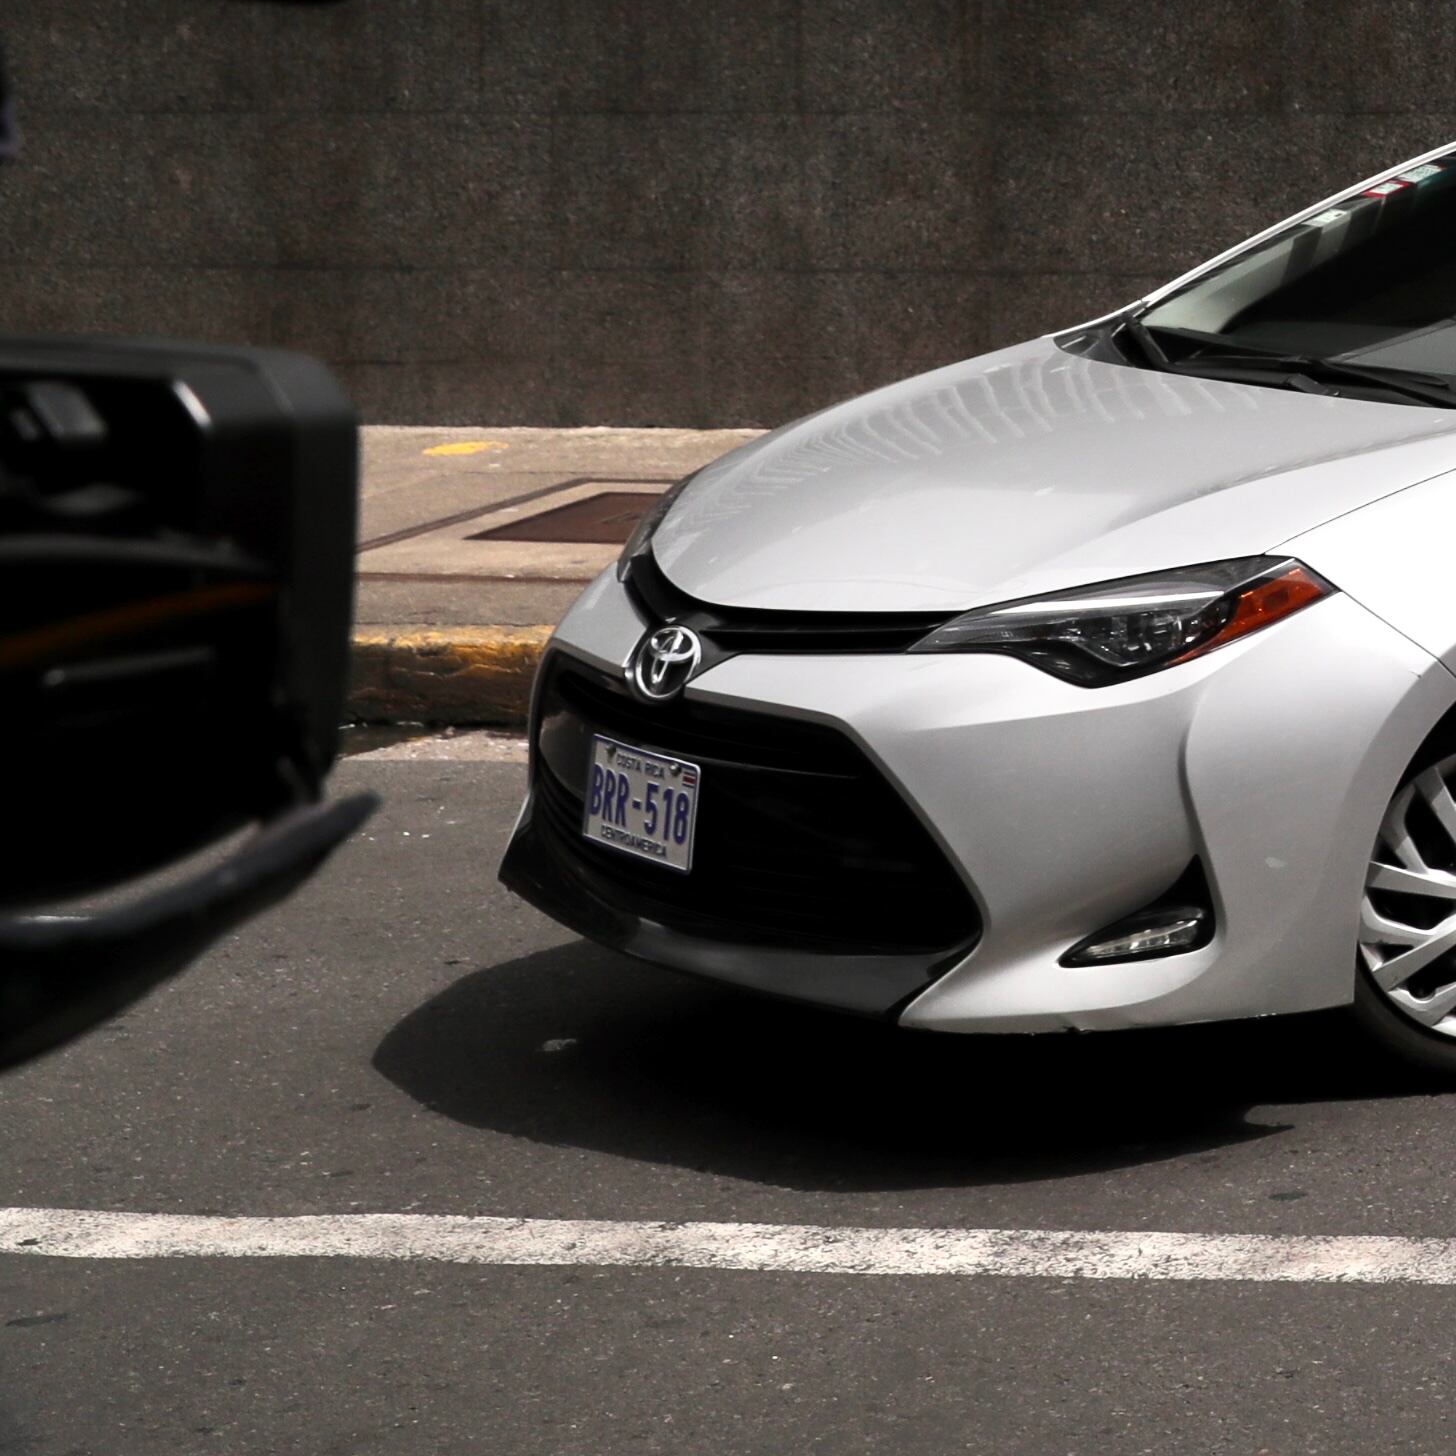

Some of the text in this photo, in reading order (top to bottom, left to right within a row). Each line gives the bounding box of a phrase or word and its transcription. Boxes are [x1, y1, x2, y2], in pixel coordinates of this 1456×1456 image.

[616, 754, 665, 780] COSTA RICA
[589, 762, 690, 845] BRR-518
[601, 824, 668, 858] CENTROAMERICA
